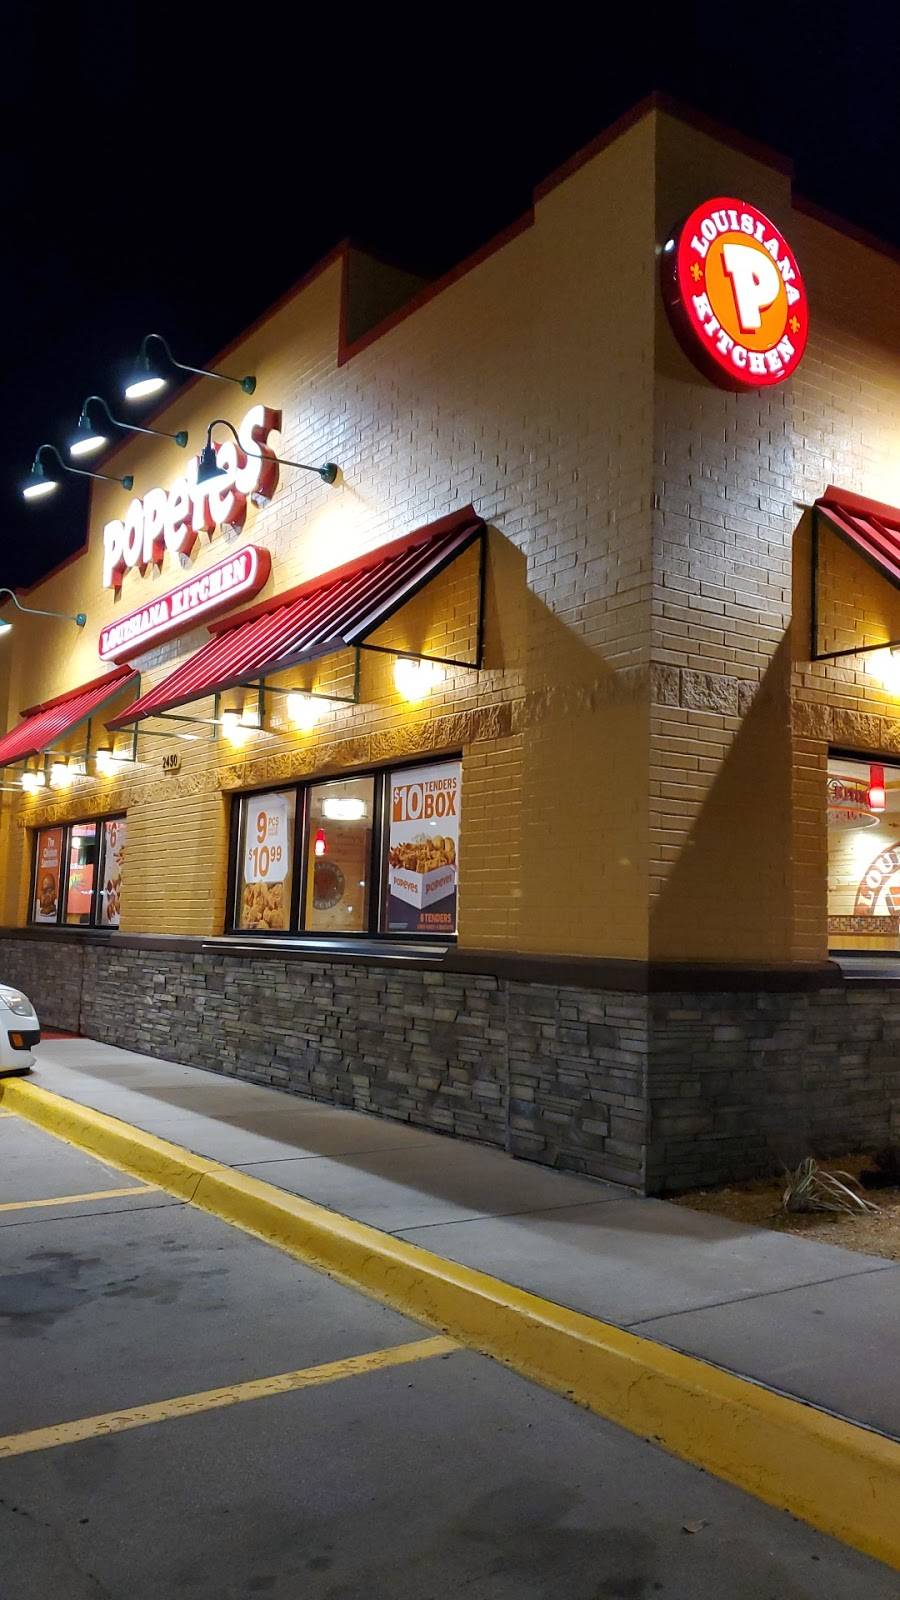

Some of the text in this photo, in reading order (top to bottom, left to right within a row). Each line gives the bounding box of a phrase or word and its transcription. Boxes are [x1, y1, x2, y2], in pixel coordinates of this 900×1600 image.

[691, 209, 801, 306] LOUISIANA
[720, 243, 780, 334] P
[692, 292, 796, 374] KITCHEN
[170, 555, 248, 616] KITCHEN
[393, 785, 423, 820] $10
[425, 777, 457, 792] TENDERS
[425, 791, 457, 818] BOX
[256, 811, 268, 844] 9
